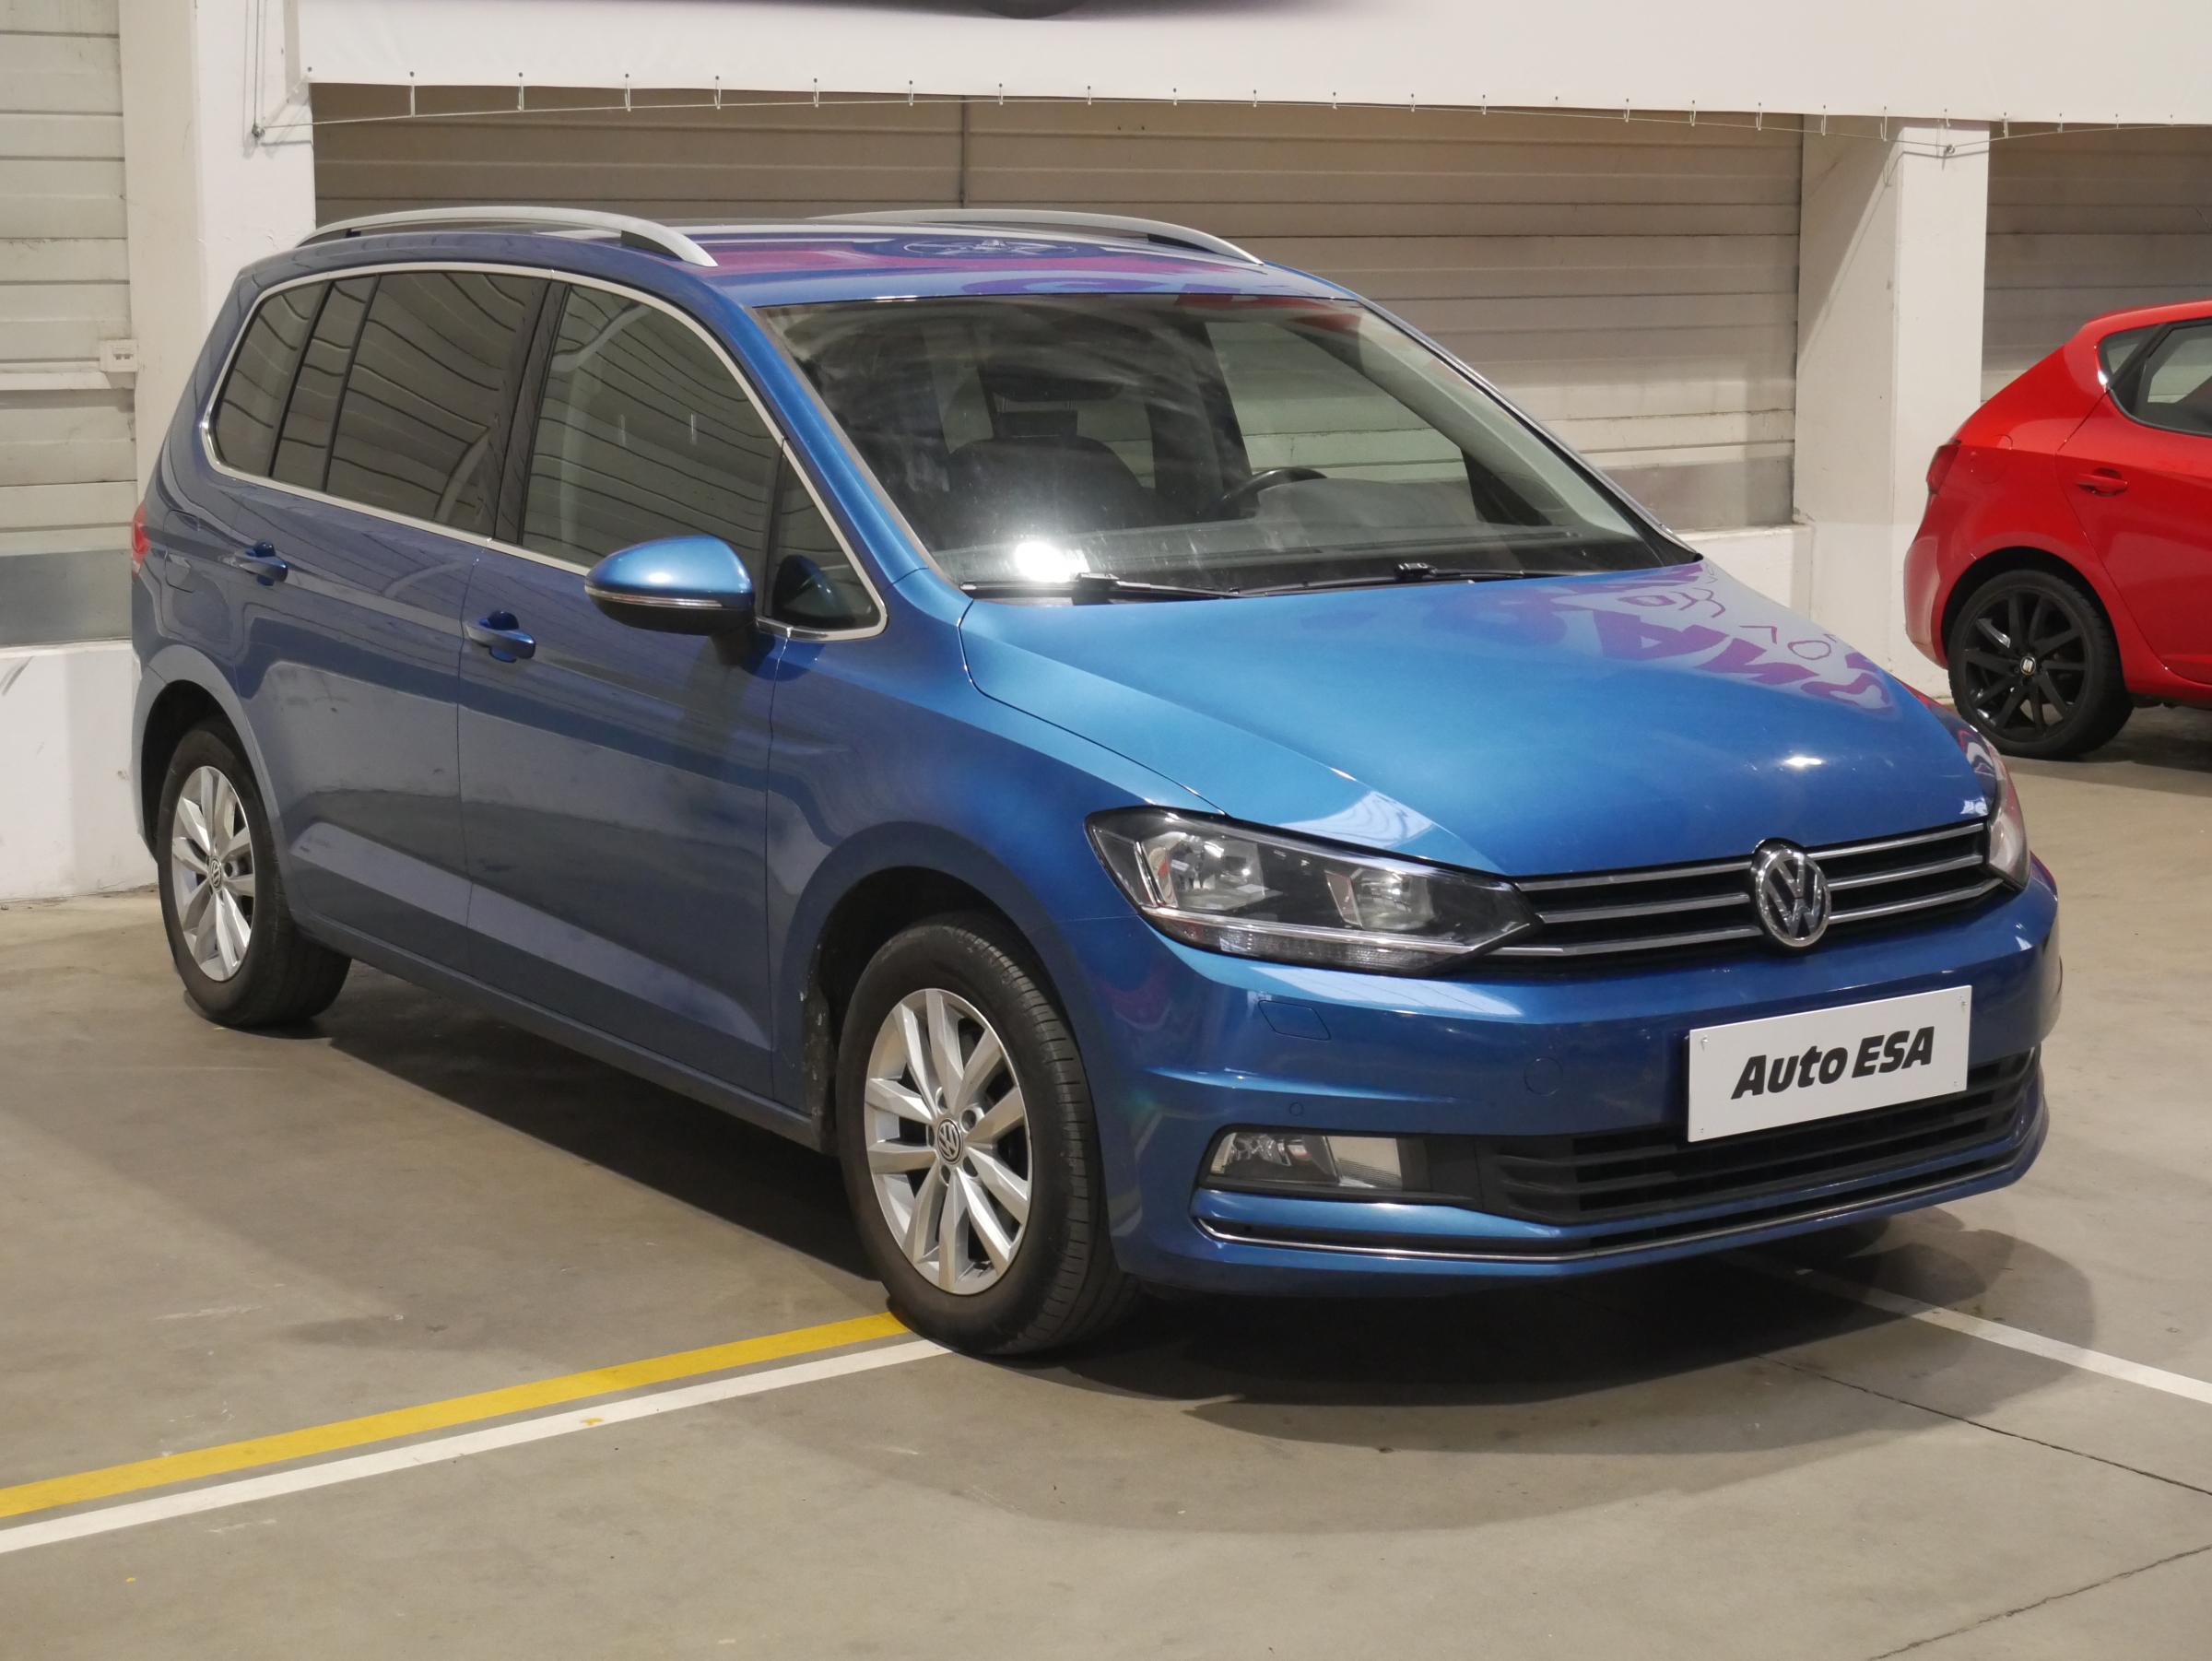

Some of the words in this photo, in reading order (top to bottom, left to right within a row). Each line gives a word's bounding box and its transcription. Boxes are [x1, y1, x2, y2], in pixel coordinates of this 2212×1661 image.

[1757, 850, 1830, 946] VW
[1731, 1045, 1848, 1100] Auto
[1852, 1026, 1935, 1078] ESA
